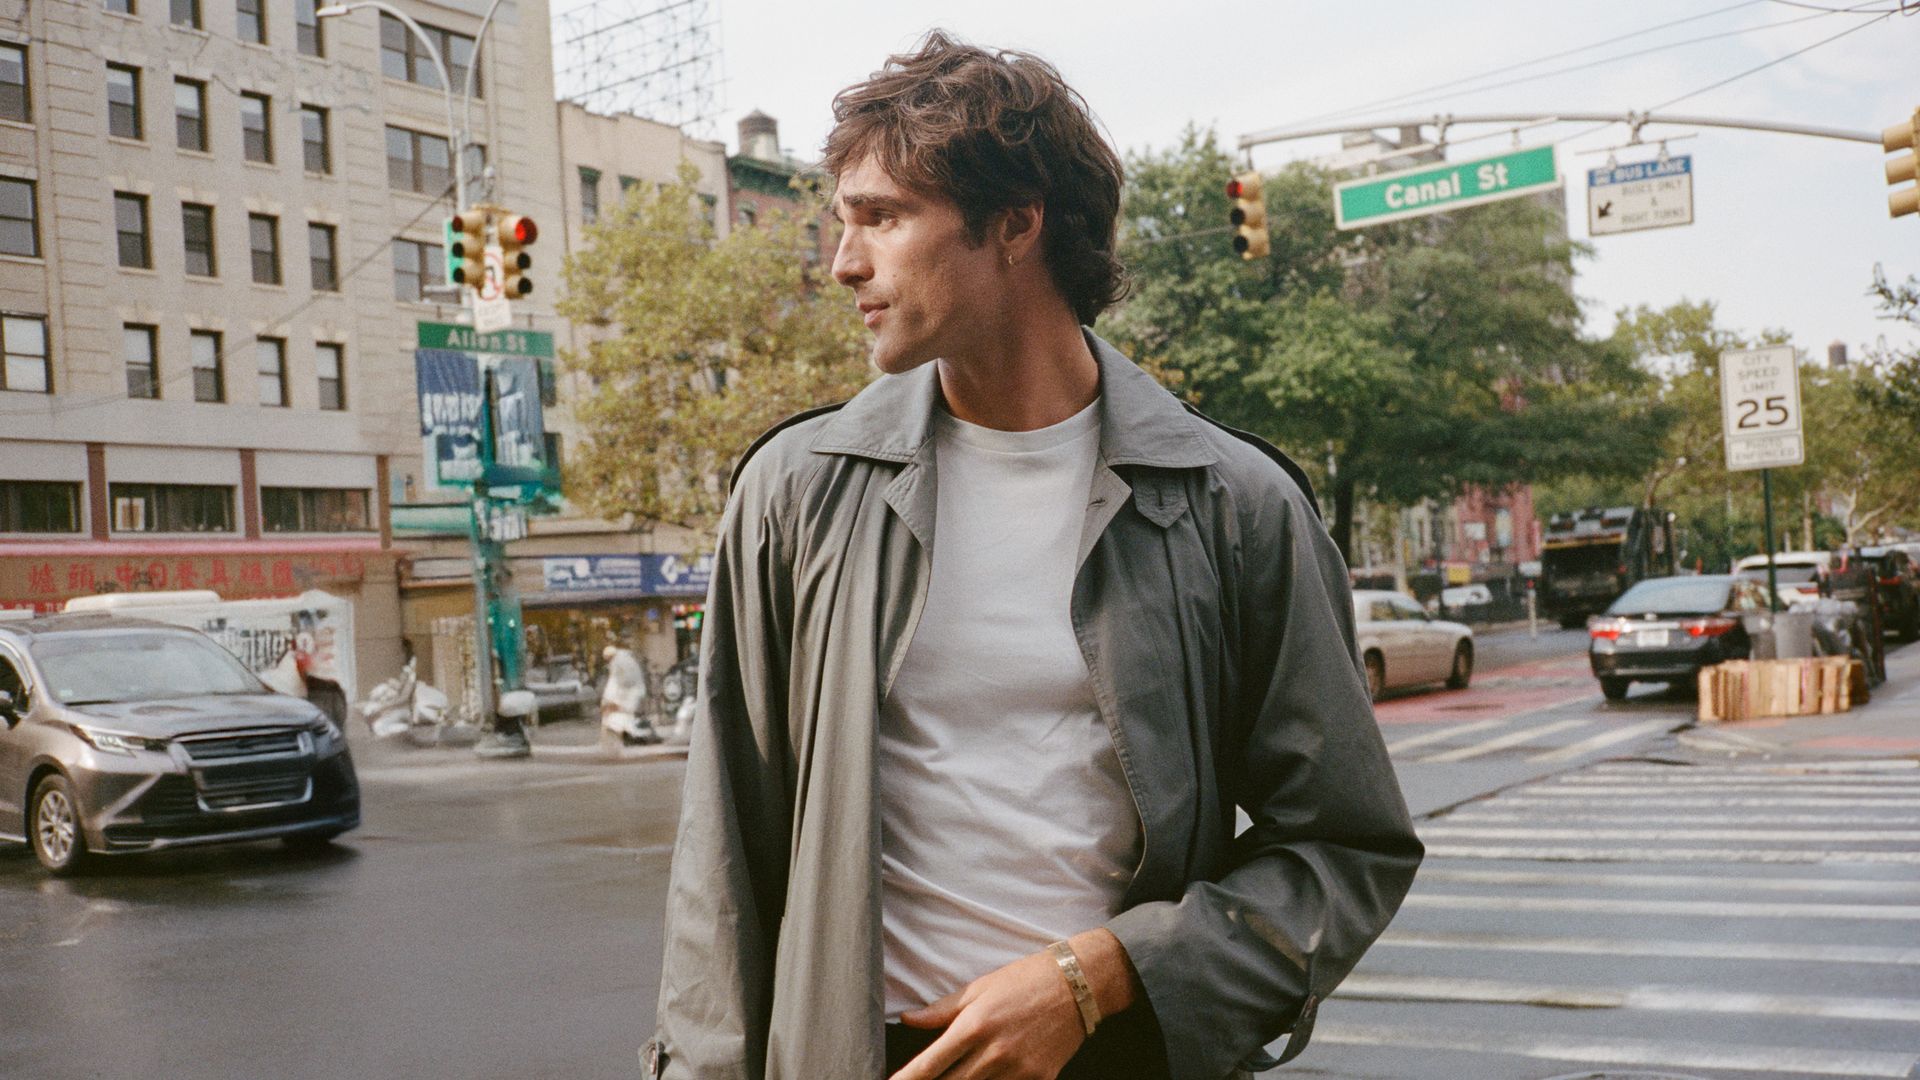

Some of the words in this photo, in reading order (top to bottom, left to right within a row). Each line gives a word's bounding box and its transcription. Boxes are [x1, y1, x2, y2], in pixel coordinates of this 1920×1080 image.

[1616, 165, 1643, 180] BUS
[1646, 161, 1685, 177] LANE
[1385, 174, 1461, 208] Canal
[1478, 164, 1508, 190] St
[447, 329, 500, 349] Allen
[506, 333, 527, 351] St
[1743, 354, 1771, 366] CITY
[1738, 367, 1779, 379] SPEED
[1742, 381, 1776, 393] LIMIT
[1736, 396, 1789, 428] 25
